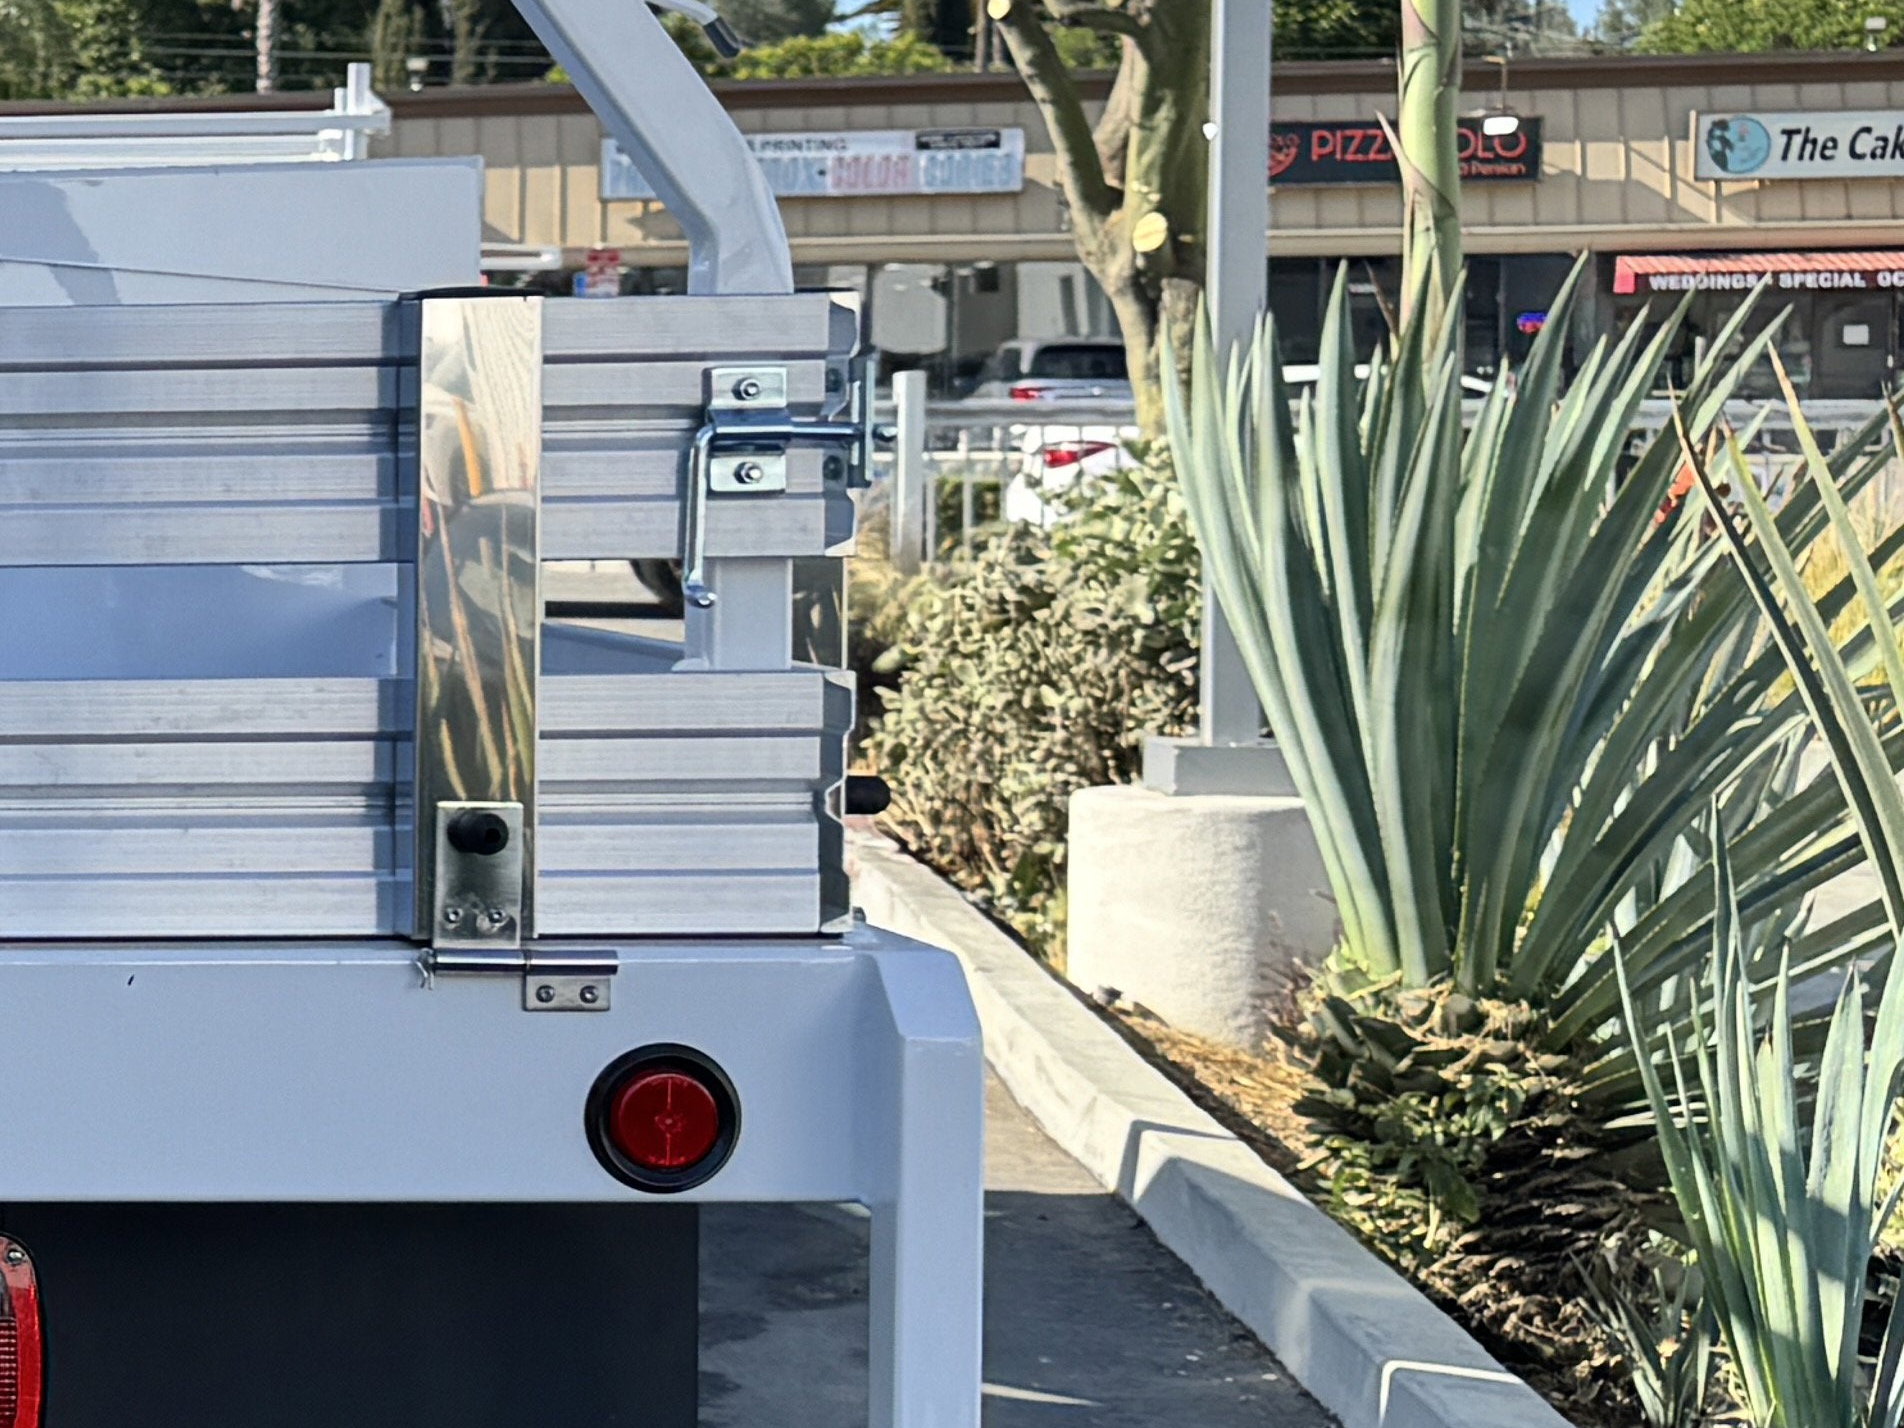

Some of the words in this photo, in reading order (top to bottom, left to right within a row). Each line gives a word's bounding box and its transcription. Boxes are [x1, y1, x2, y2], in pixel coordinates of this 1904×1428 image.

[1311, 129, 1395, 161] PIZZ
[1780, 125, 1839, 162] The
[1779, 273, 1866, 289] SPECIAL
